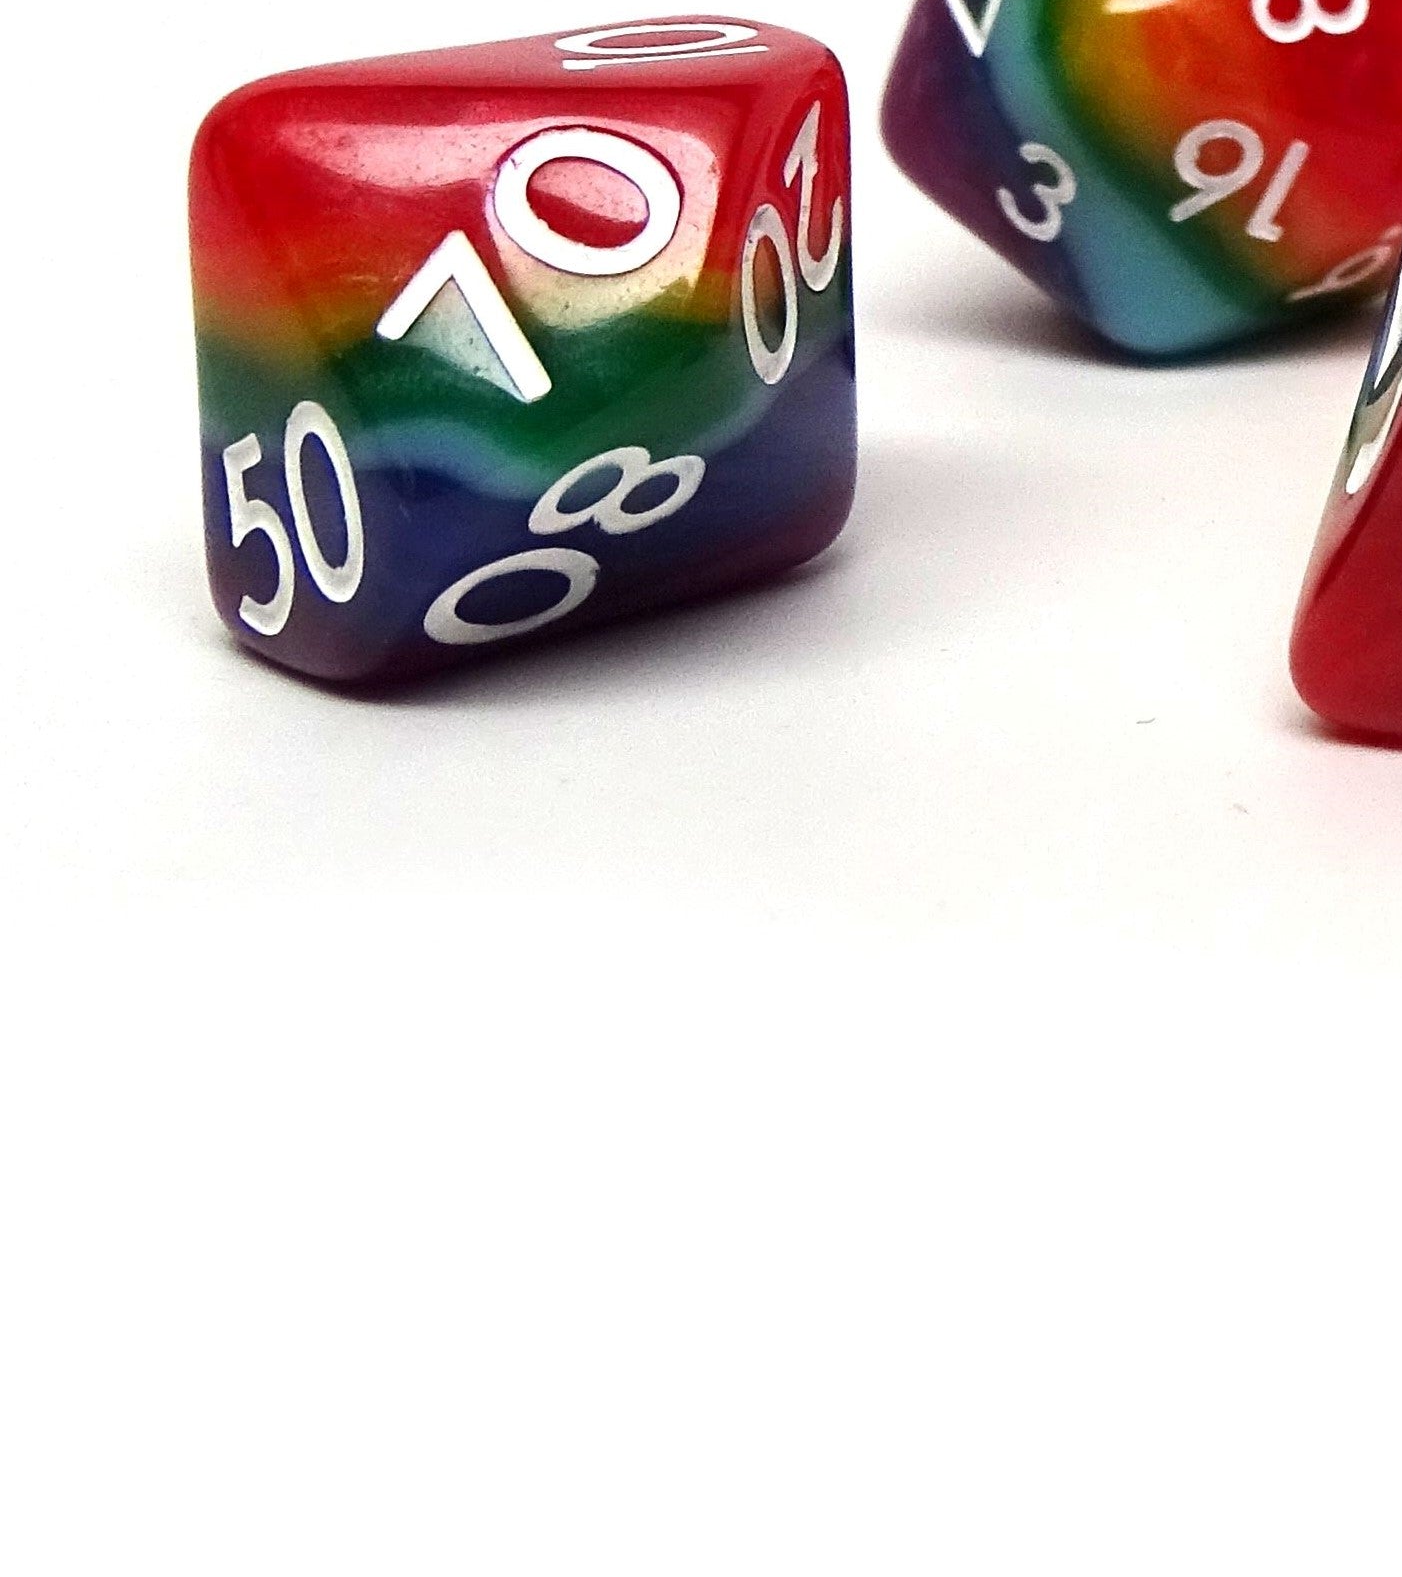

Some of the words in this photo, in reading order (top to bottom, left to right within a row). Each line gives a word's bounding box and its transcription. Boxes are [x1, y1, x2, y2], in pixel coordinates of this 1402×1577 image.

[552, 21, 770, 73] 10
[374, 123, 685, 405] 70
[738, 98, 843, 386] 20
[997, 141, 1079, 243] 3
[1168, 117, 1310, 245] 16
[221, 399, 366, 637] 50
[422, 445, 706, 645] 80
